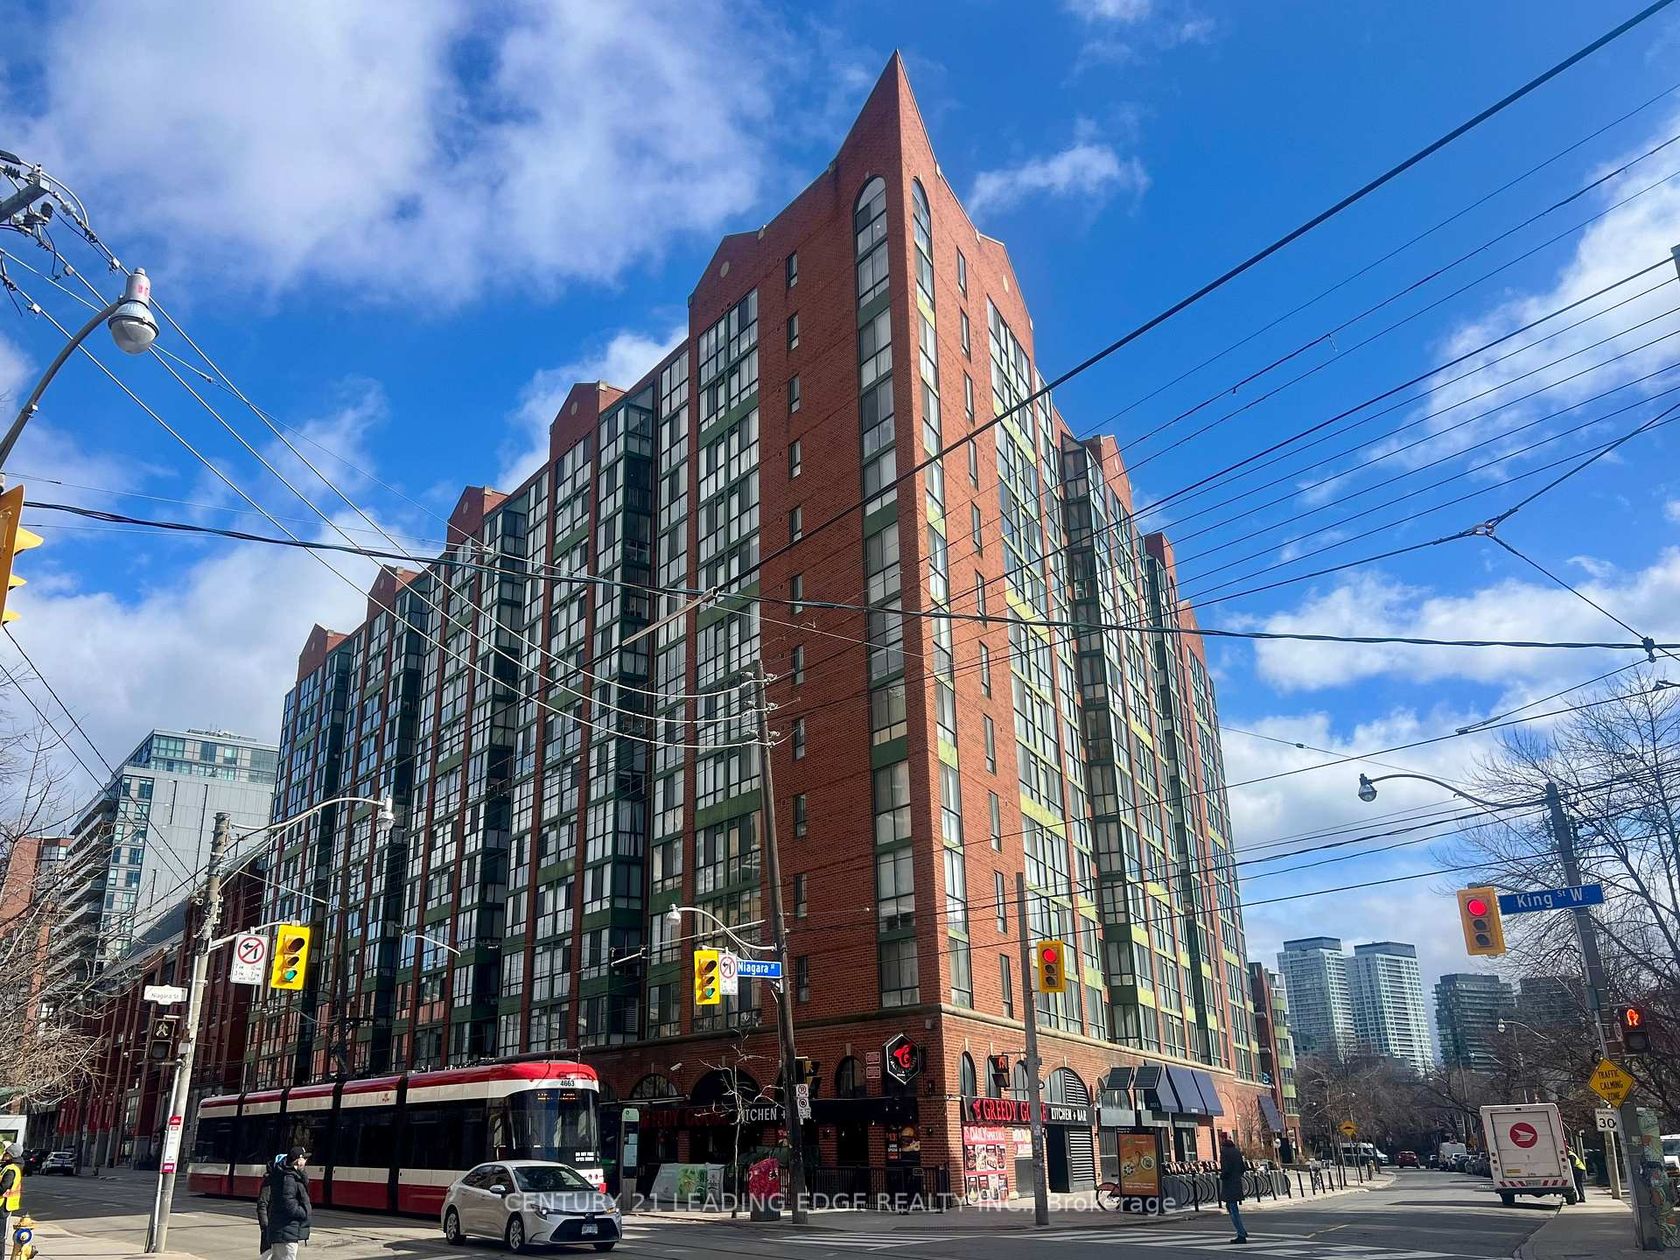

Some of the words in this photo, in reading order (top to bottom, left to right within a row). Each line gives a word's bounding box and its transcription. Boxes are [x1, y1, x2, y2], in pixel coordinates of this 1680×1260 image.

[1517, 894, 1553, 908] King
[1569, 888, 1583, 901] W
[738, 962, 769, 976] Niagara
[1598, 1069, 1620, 1079] TRAFFIC
[1600, 1080, 1623, 1090] CALMING
[1607, 1092, 1621, 1100] ZONE
[982, 1099, 1017, 1120] GREEDY
[1051, 1107, 1072, 1120] KITCHEN
[1077, 1109, 1087, 1121] BAR
[1599, 1118, 1616, 1128] 30
[970, 1126, 986, 1141] DAILY
